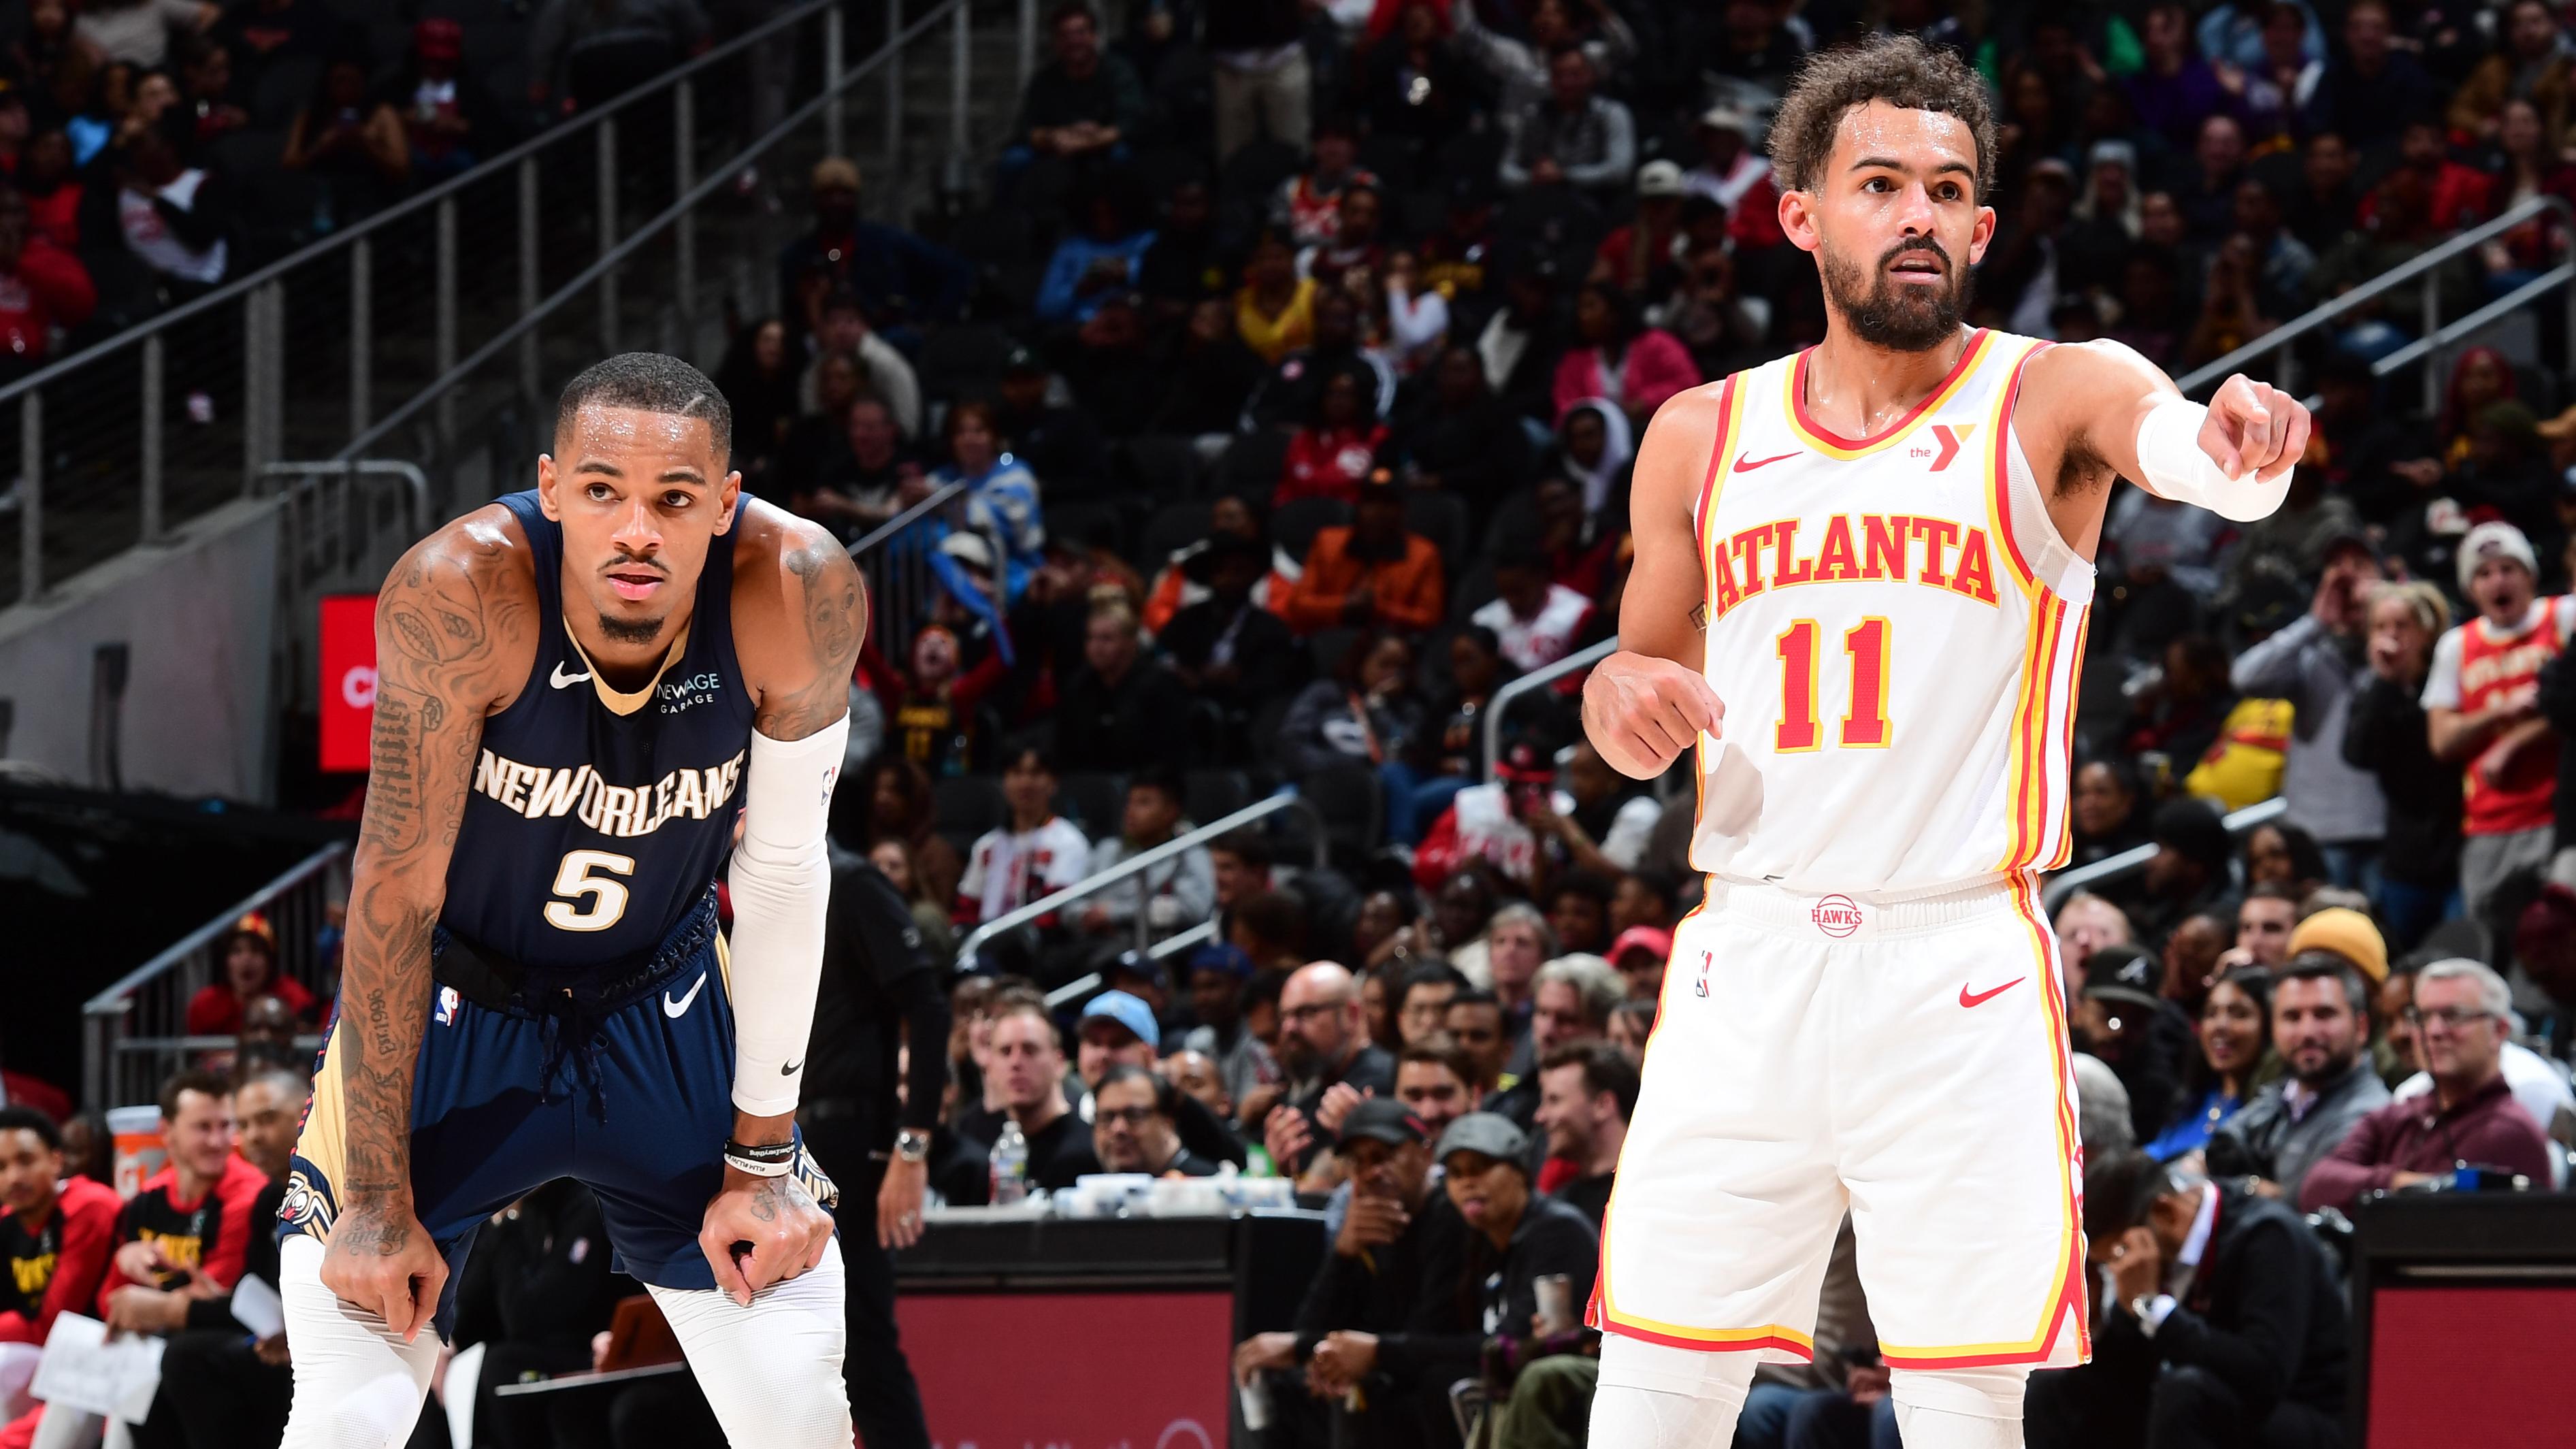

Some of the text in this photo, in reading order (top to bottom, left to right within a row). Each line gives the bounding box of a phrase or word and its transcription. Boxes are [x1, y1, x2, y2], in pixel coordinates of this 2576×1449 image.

[1910, 447, 1931, 458] the
[1715, 512, 2001, 622] ATLANTA
[342, 666, 378, 708] C
[661, 694, 714, 714] GARAGE
[1774, 615, 1894, 754] 11
[543, 849, 635, 932] 5
[1811, 909, 1863, 924] HAWKS
